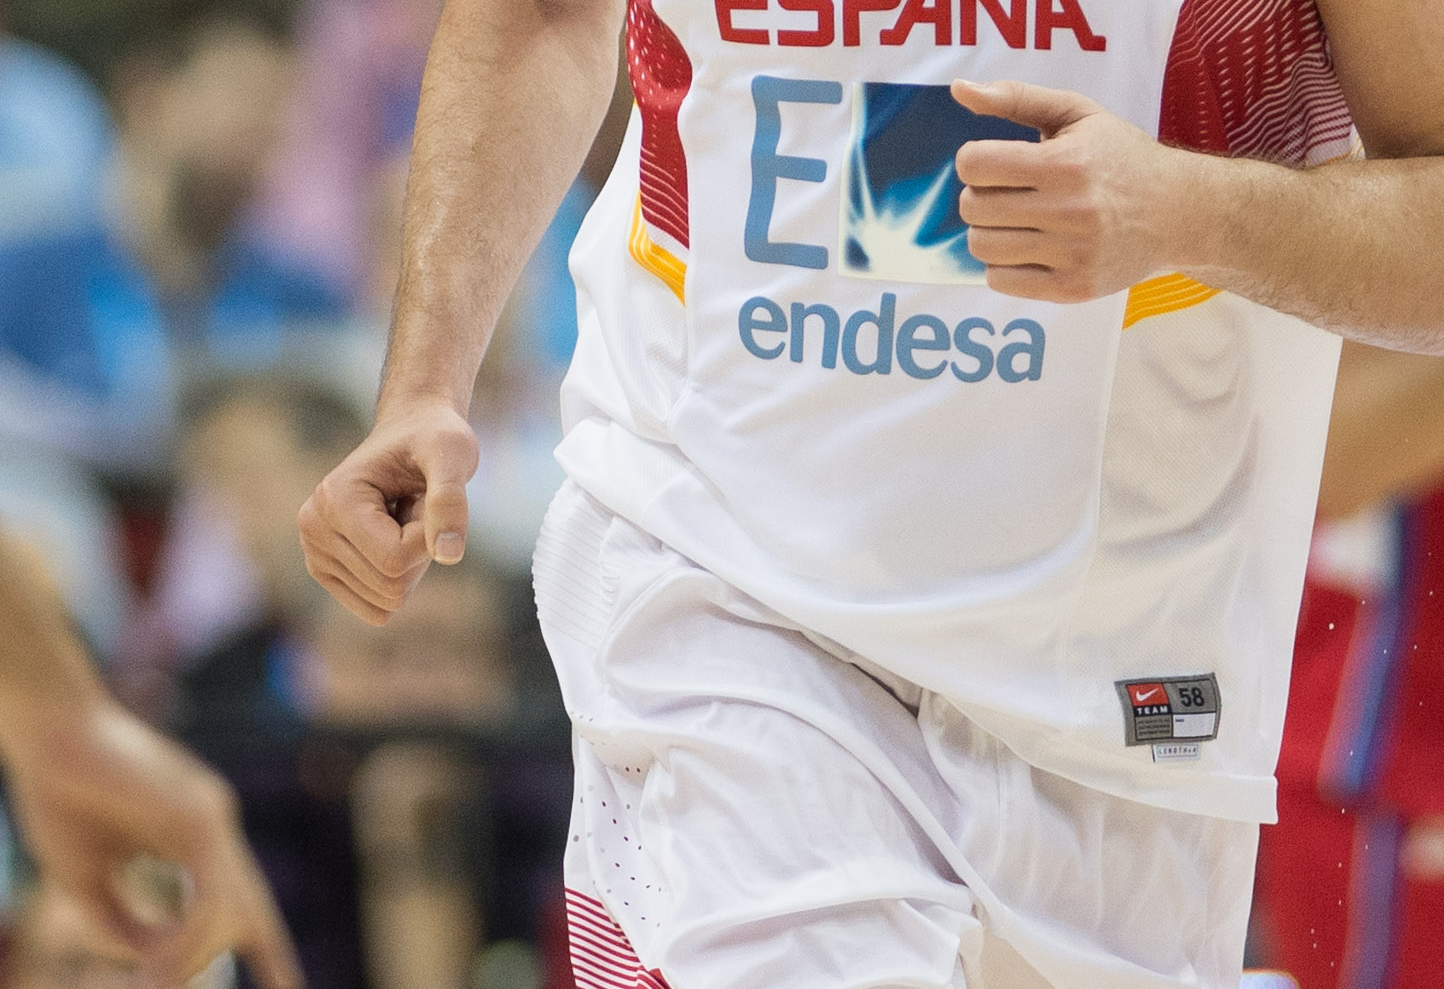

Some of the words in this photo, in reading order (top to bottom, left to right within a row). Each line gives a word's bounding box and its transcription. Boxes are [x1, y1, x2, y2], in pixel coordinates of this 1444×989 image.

[738, 293, 1046, 383] endesa
[1179, 687, 1205, 707] 58
[1137, 705, 1168, 715] TEAM
